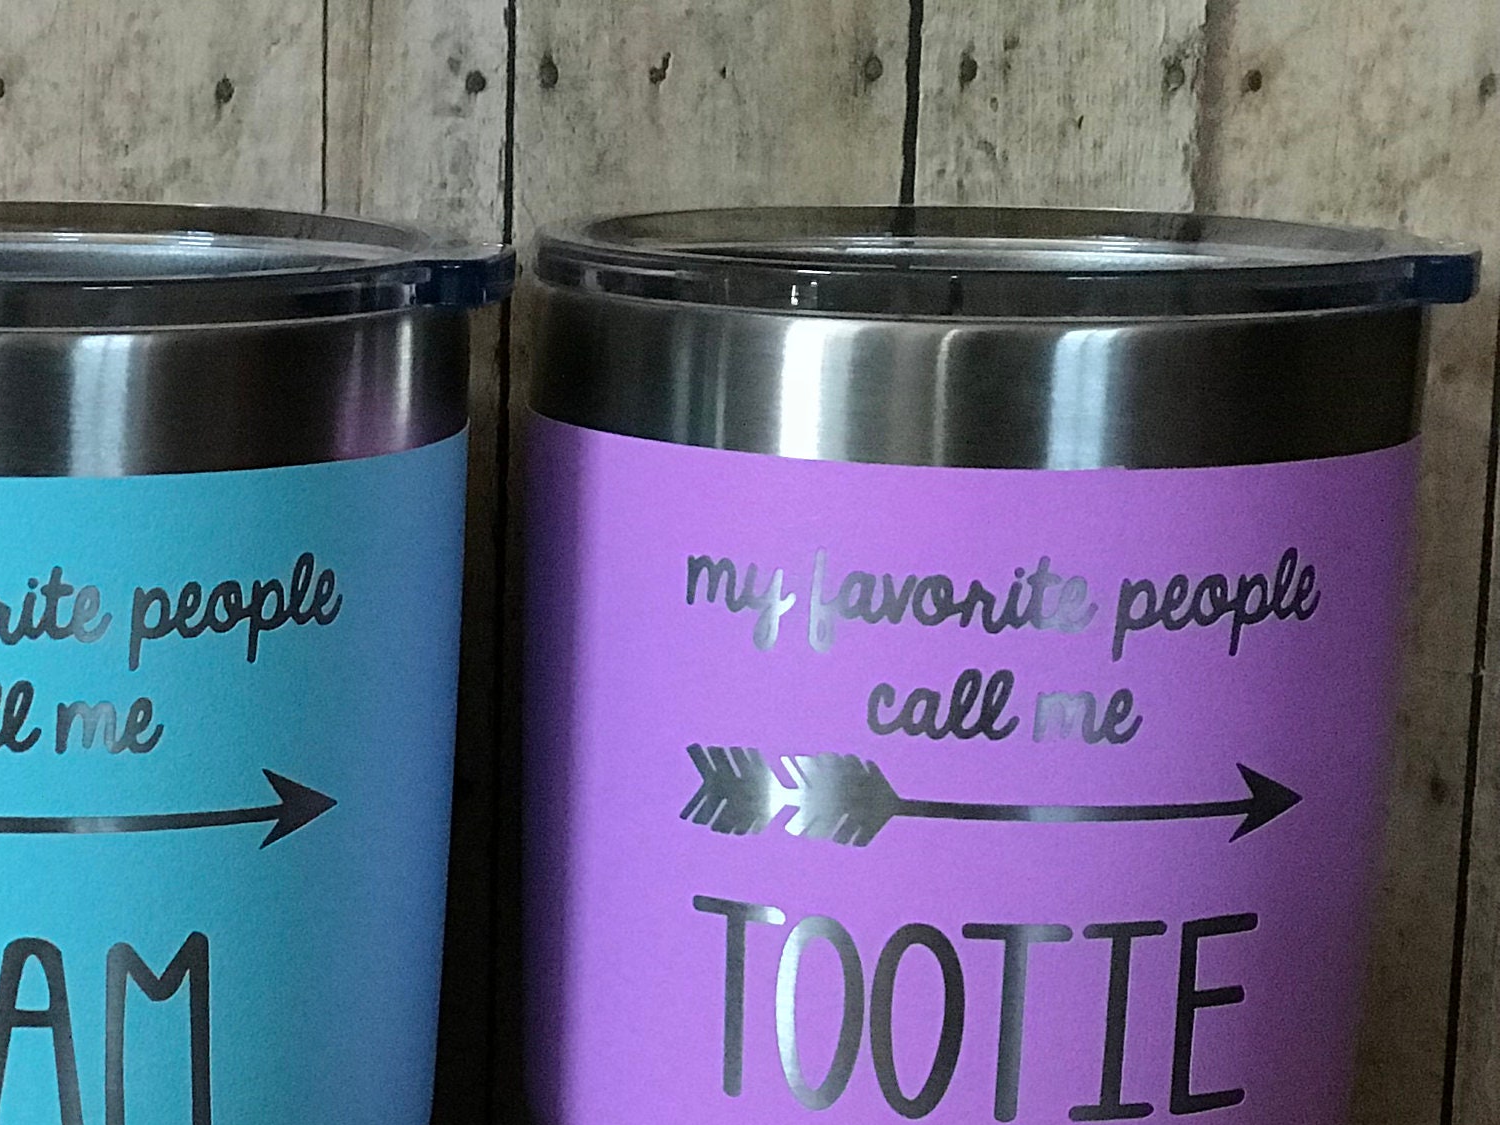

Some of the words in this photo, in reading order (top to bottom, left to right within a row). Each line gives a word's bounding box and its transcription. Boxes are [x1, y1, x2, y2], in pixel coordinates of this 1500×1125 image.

[129, 552, 343, 672] people
[686, 554, 797, 653] my
[807, 545, 1098, 654] favorite
[1111, 547, 1321, 662] people
[55, 697, 164, 755] me
[866, 668, 1019, 741] call
[1032, 688, 1143, 744] me
[692, 894, 1258, 1124] TOOTIE
